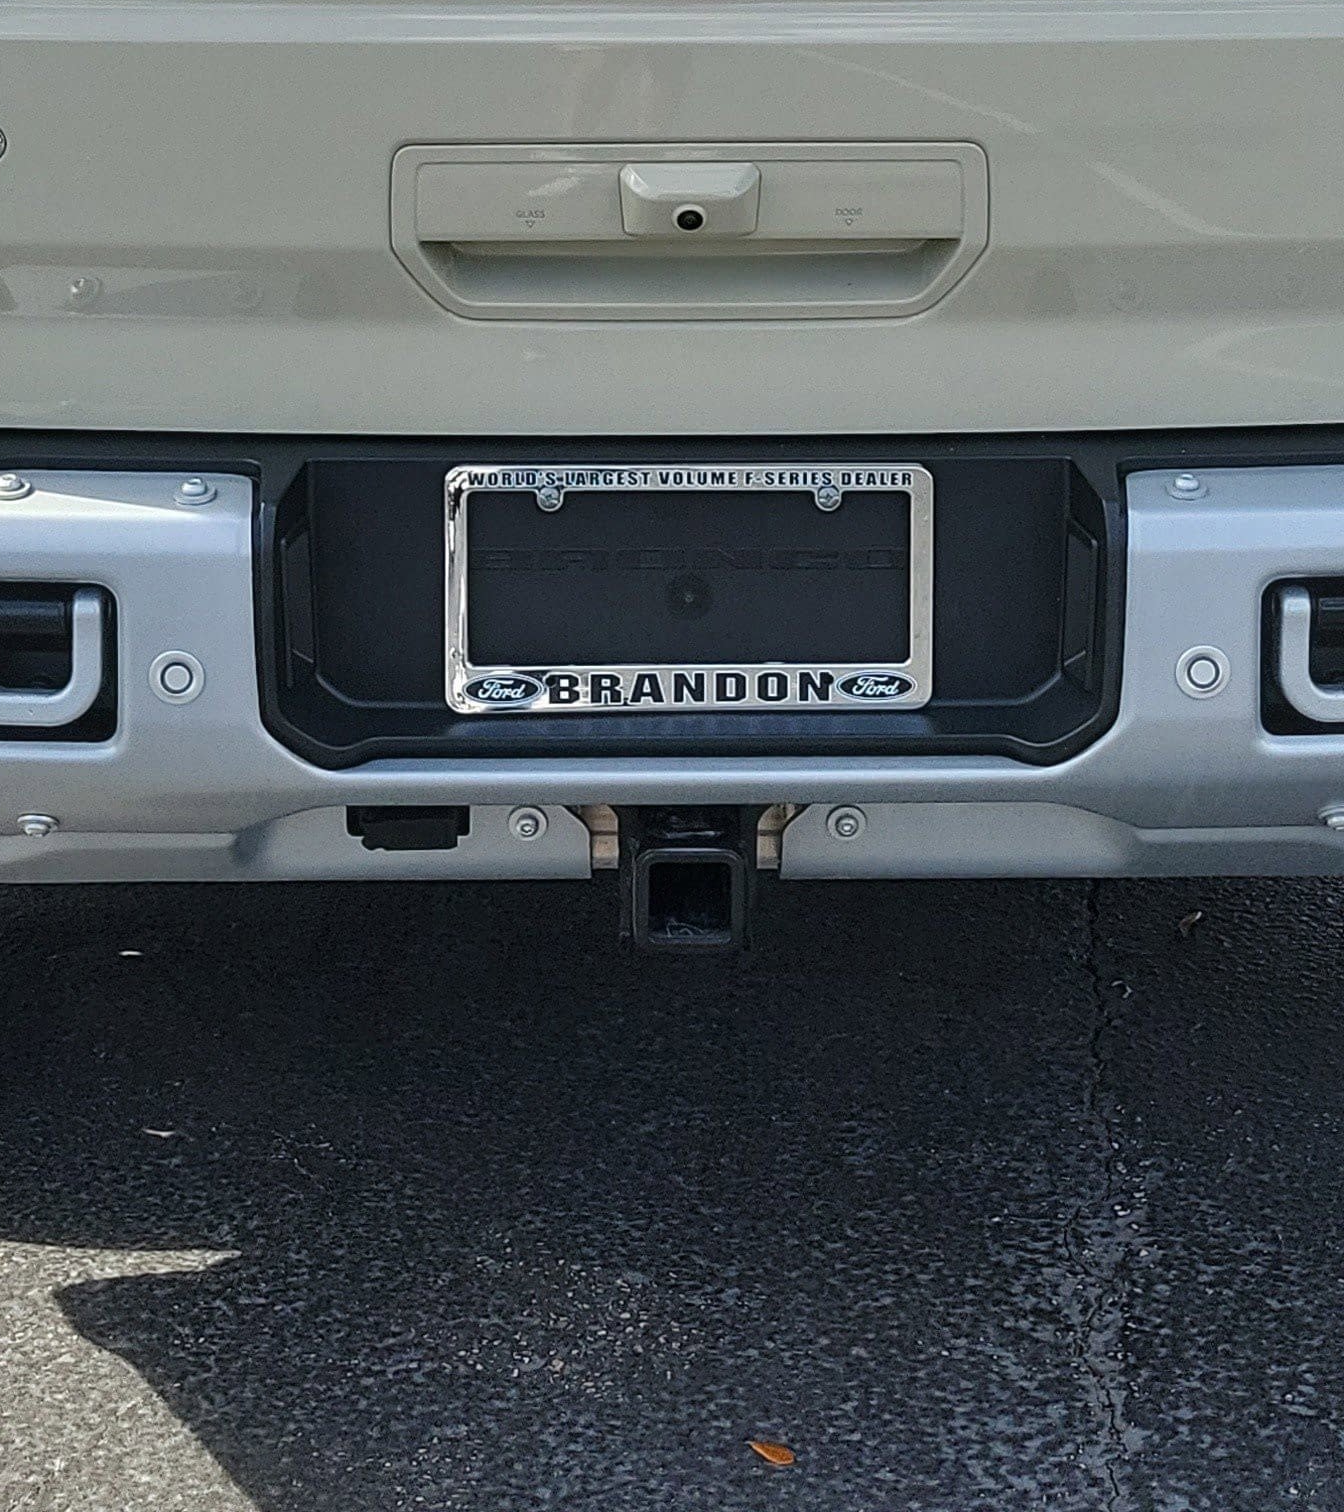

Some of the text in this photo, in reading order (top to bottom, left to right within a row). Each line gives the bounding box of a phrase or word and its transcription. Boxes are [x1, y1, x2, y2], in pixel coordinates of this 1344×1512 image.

[468, 471, 913, 486] WORLD'S LARGEST VOLUME F-SERIES DEALER
[478, 671, 901, 705] Ford BRANDON Ford
